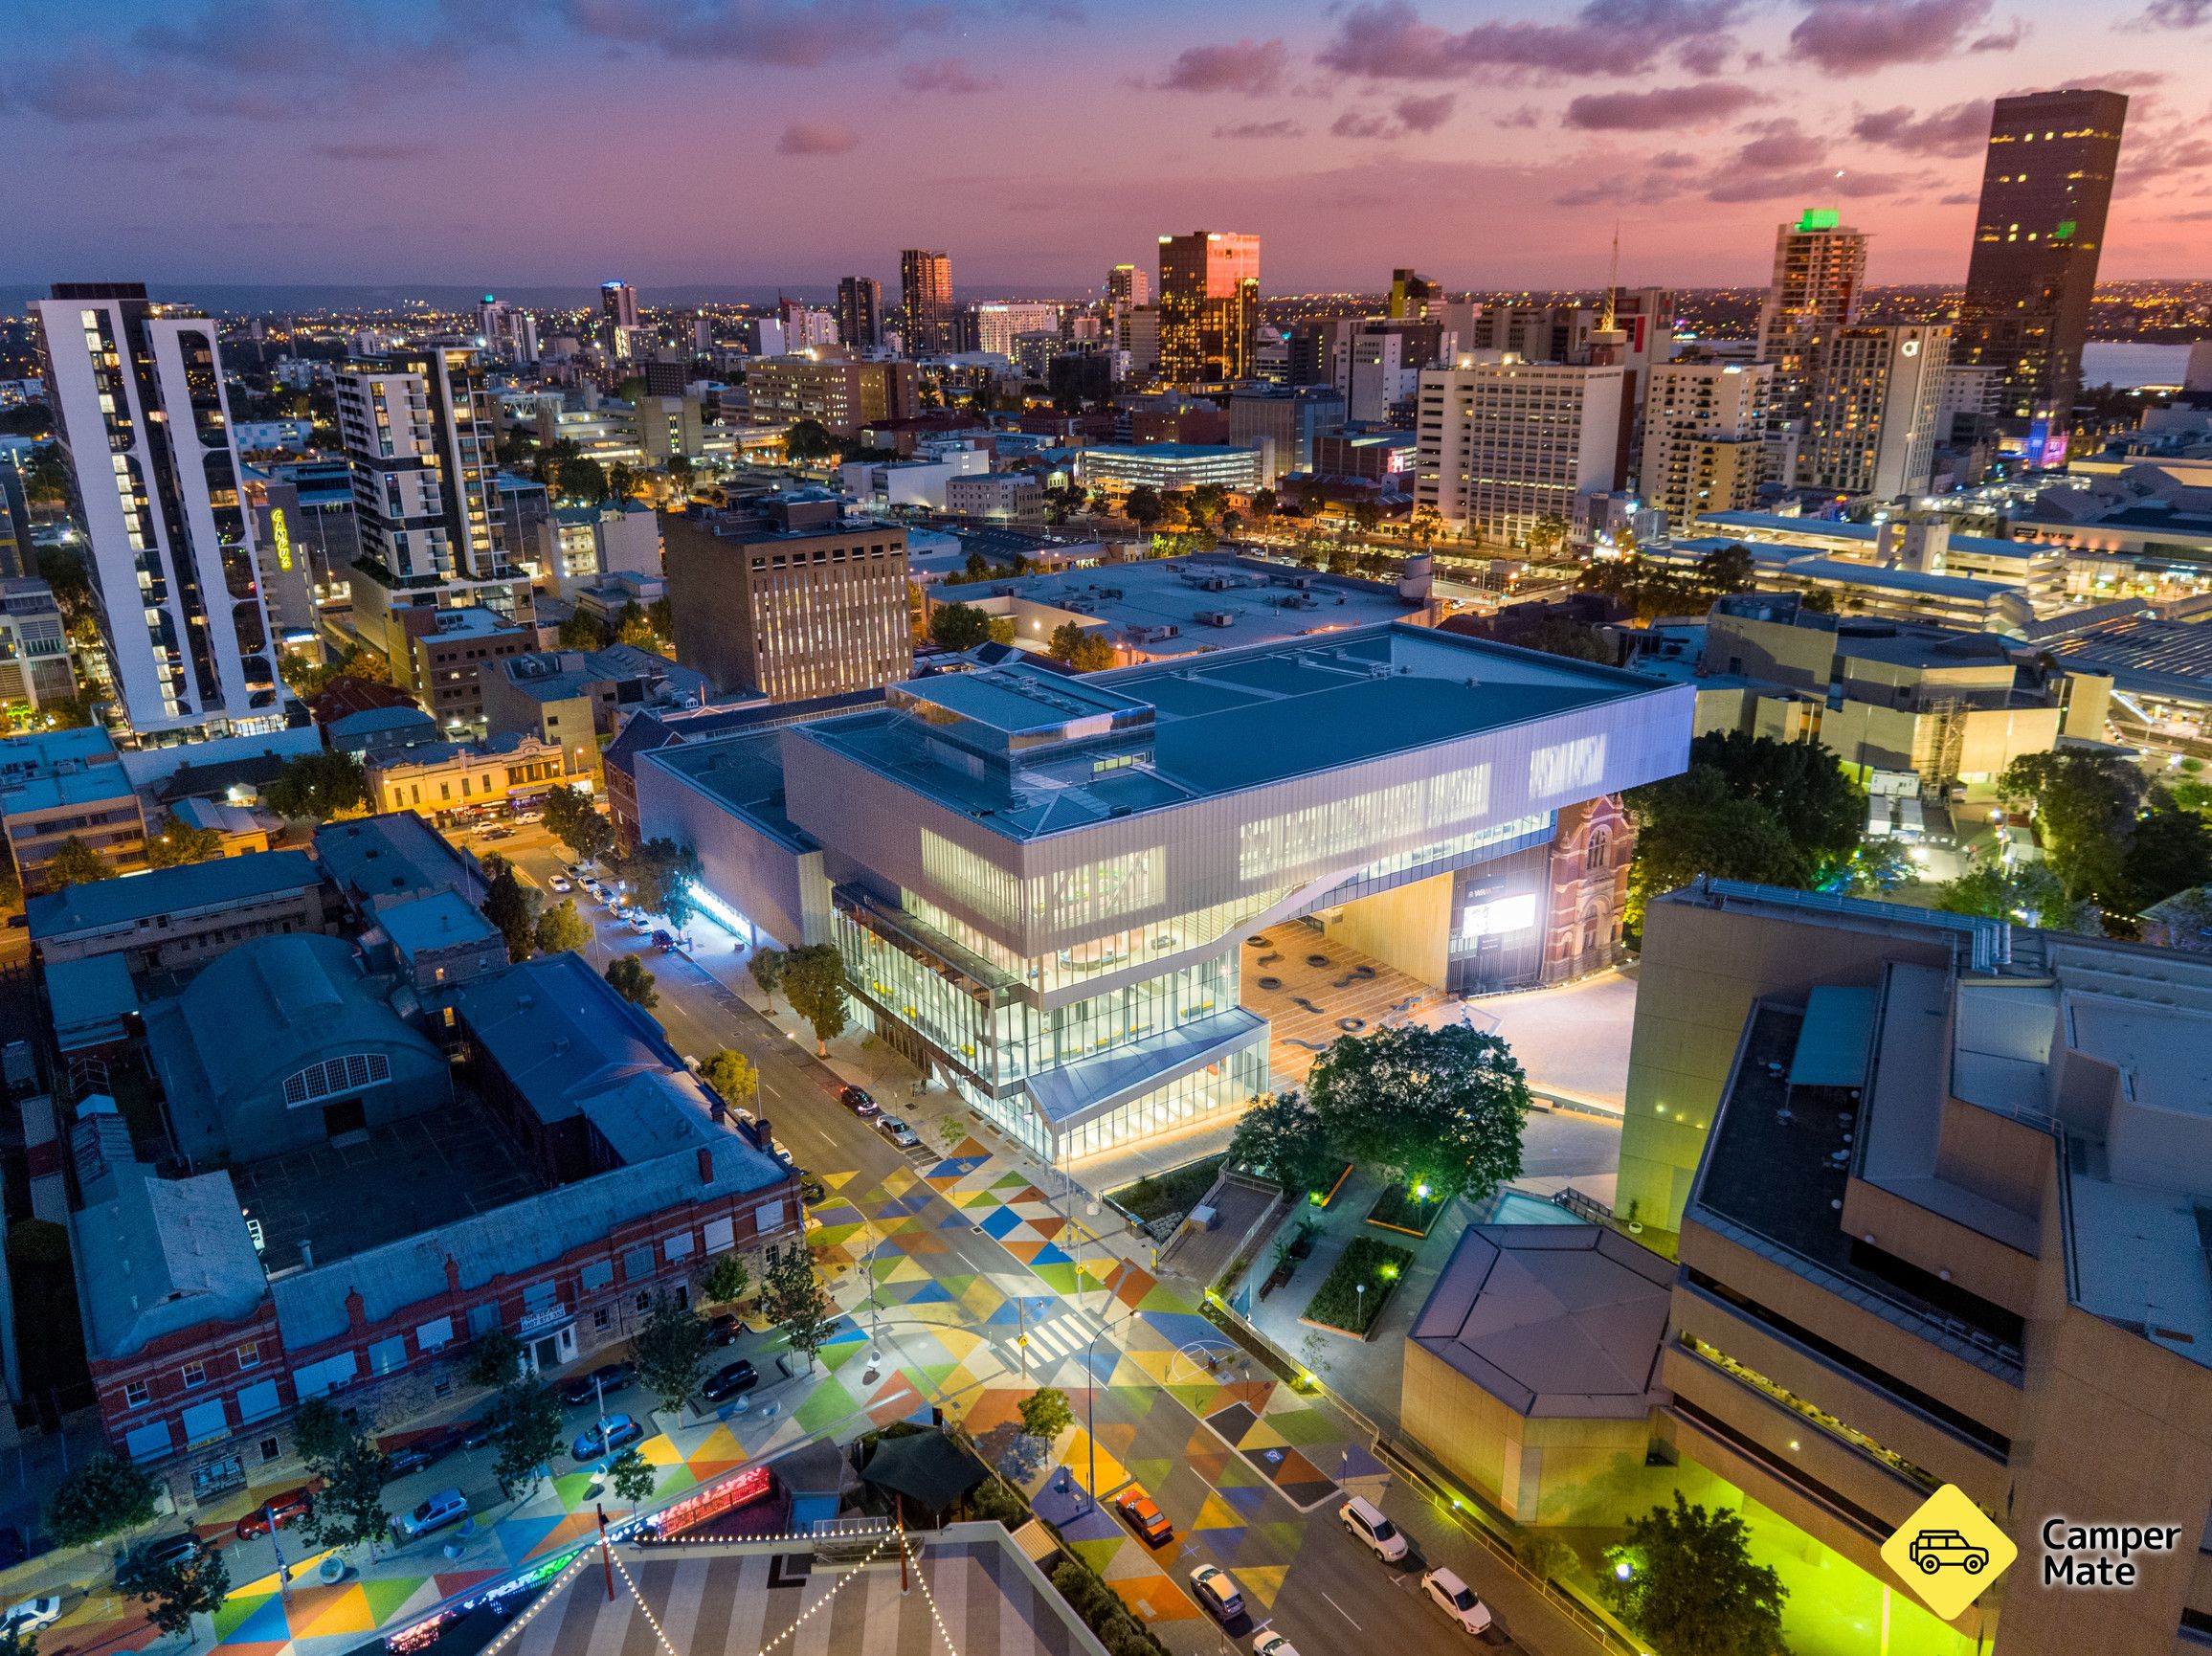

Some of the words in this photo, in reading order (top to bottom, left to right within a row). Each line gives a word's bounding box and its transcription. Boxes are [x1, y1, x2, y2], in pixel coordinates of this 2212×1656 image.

[272, 508, 291, 570] CAMPUS
[521, 1312, 538, 1324] FOR
[539, 1303, 564, 1318] LEASE
